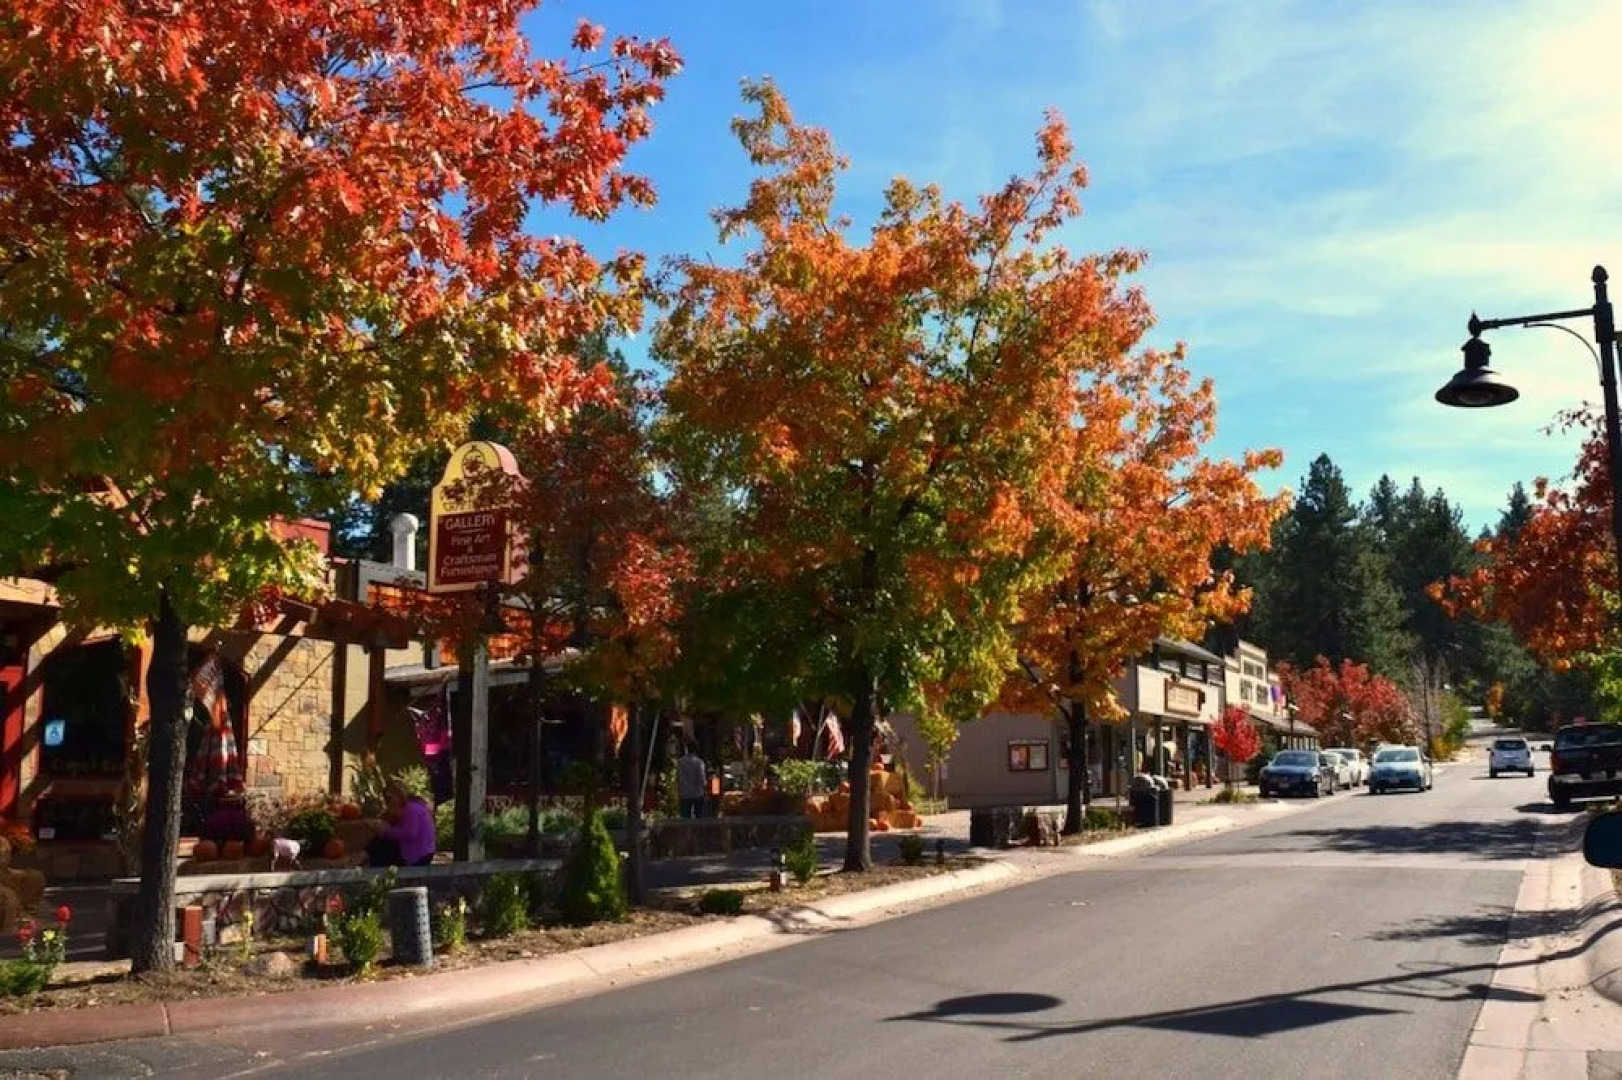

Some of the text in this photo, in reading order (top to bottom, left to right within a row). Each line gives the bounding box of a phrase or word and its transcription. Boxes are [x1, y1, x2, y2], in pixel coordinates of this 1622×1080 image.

[445, 514, 495, 530] GALLERY
[452, 533, 490, 546] Fine Art
